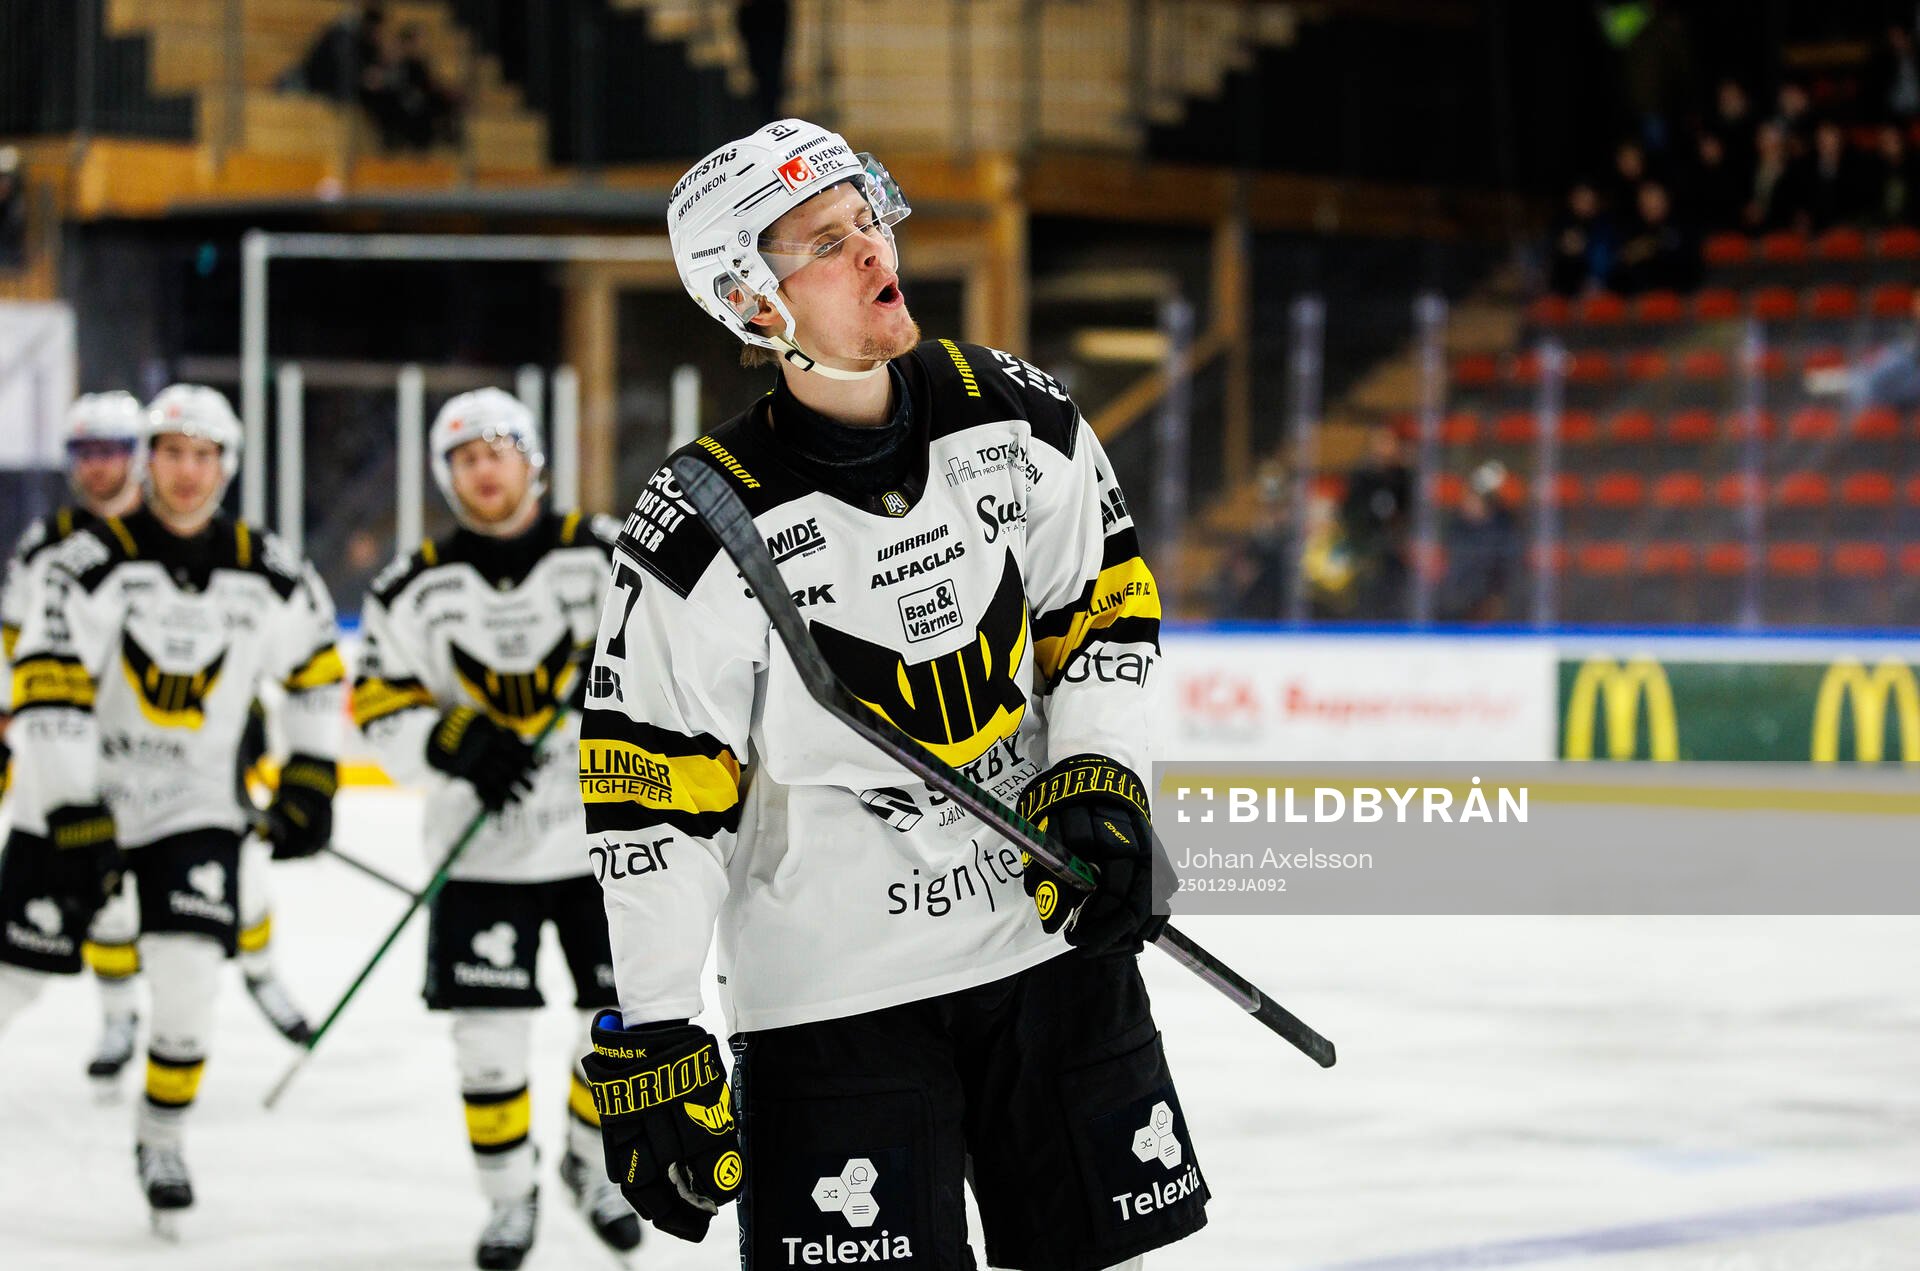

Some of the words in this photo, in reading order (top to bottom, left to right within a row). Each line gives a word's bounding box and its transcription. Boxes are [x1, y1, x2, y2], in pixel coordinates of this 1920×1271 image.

[785, 135, 829, 161] WARRIOR
[815, 159, 844, 176] SPEL
[678, 196, 696, 221] SKYLT
[701, 172, 727, 197] NEON
[937, 338, 982, 398] WARRIOR
[695, 435, 761, 489] WARRIOR
[877, 523, 949, 562] WARRIOR
[870, 541, 966, 590] ALFAGLAS
[904, 598, 938, 621] Bad
[935, 585, 954, 610] &
[908, 610, 958, 637] Värme
[1103, 821, 1131, 845] COVERT
[635, 1048, 648, 1059] IK
[627, 1148, 639, 1184] COVERT
[1111, 1163, 1201, 1222] Telexia
[782, 1229, 914, 1267] Telexia
